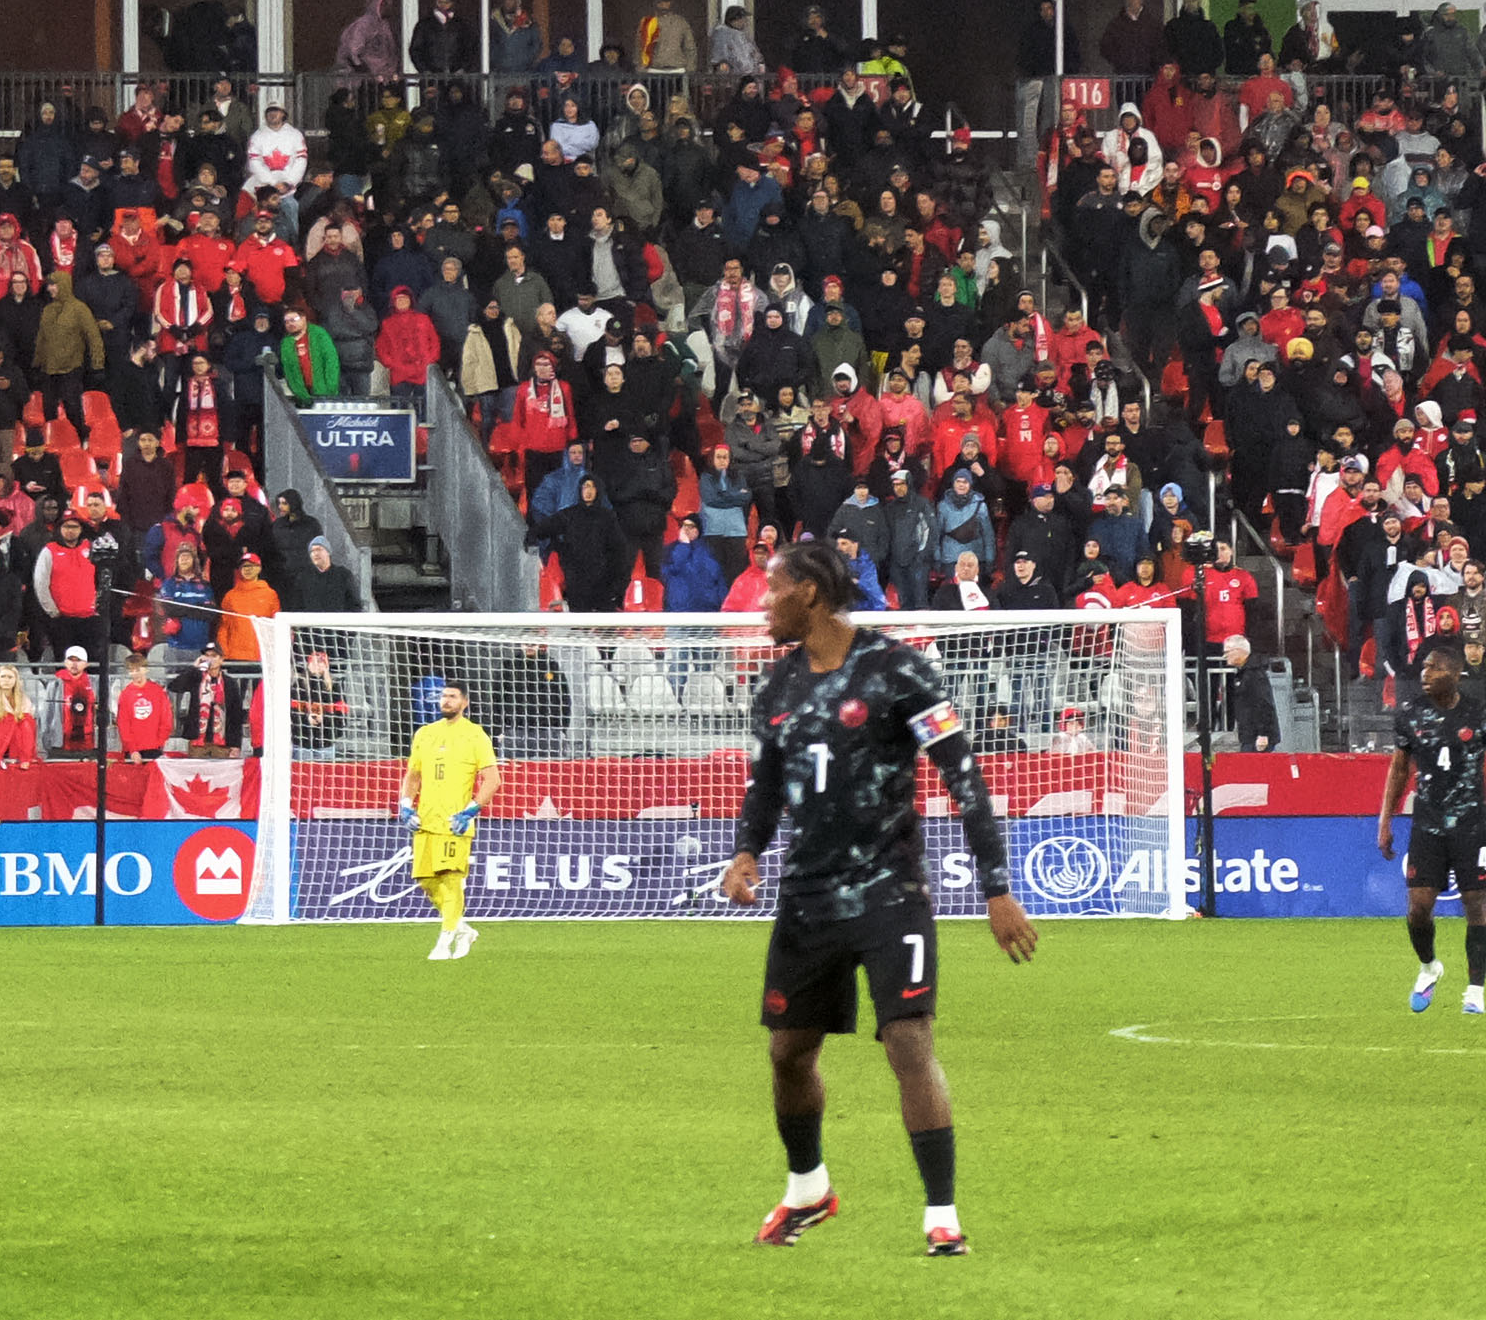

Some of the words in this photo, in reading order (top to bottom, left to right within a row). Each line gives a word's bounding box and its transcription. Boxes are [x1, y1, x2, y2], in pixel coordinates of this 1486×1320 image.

[1069, 81, 1103, 106] 116
[315, 429, 395, 449] ULTRA
[1436, 745, 1452, 773] 4
[434, 763, 445, 781] 16
[443, 841, 457, 858] 16
[468, 854, 635, 892] ELUS
